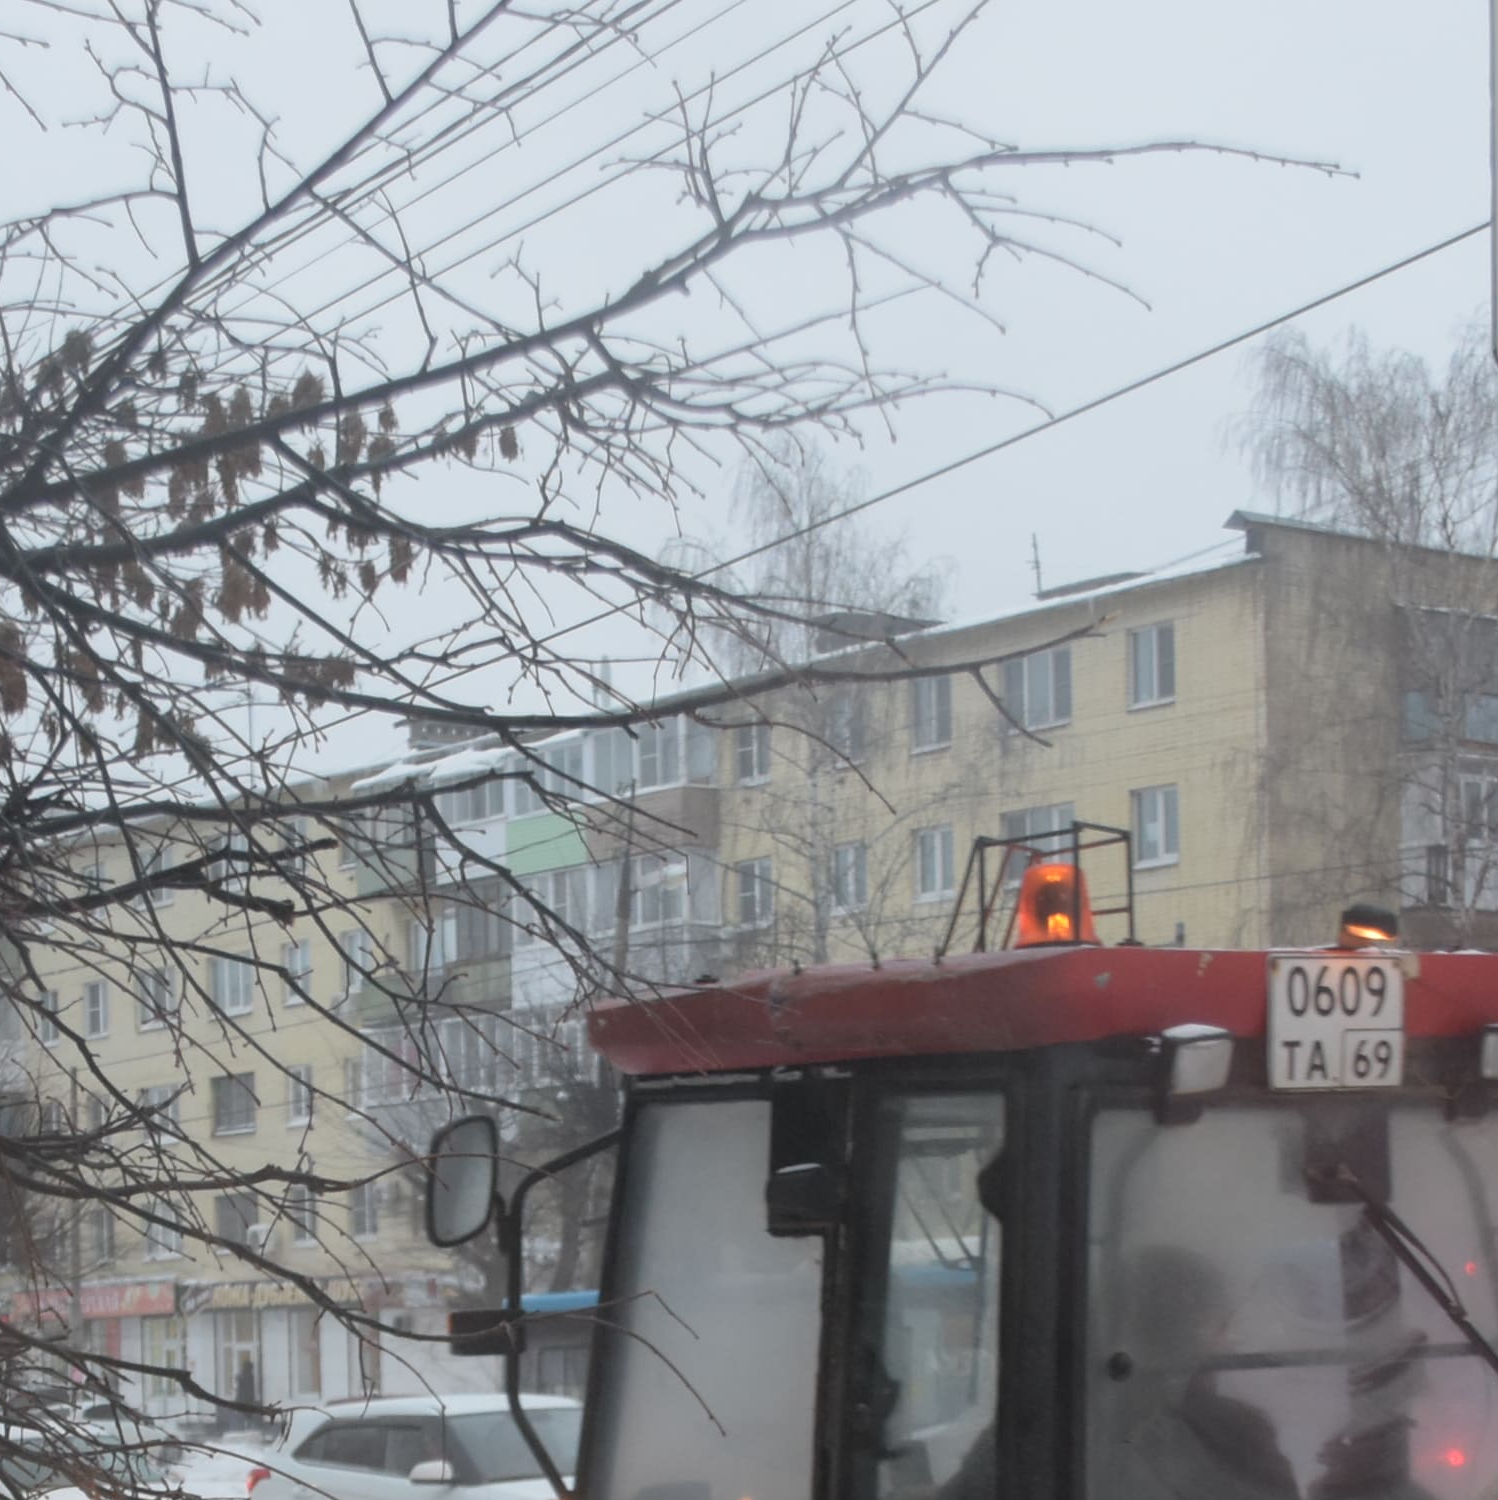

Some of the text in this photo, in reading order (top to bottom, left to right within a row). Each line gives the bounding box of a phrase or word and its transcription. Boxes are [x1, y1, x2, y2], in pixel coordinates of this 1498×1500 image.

[1286, 965, 1387, 1018] 0609
[1282, 1040, 1392, 1081] ТА 69
